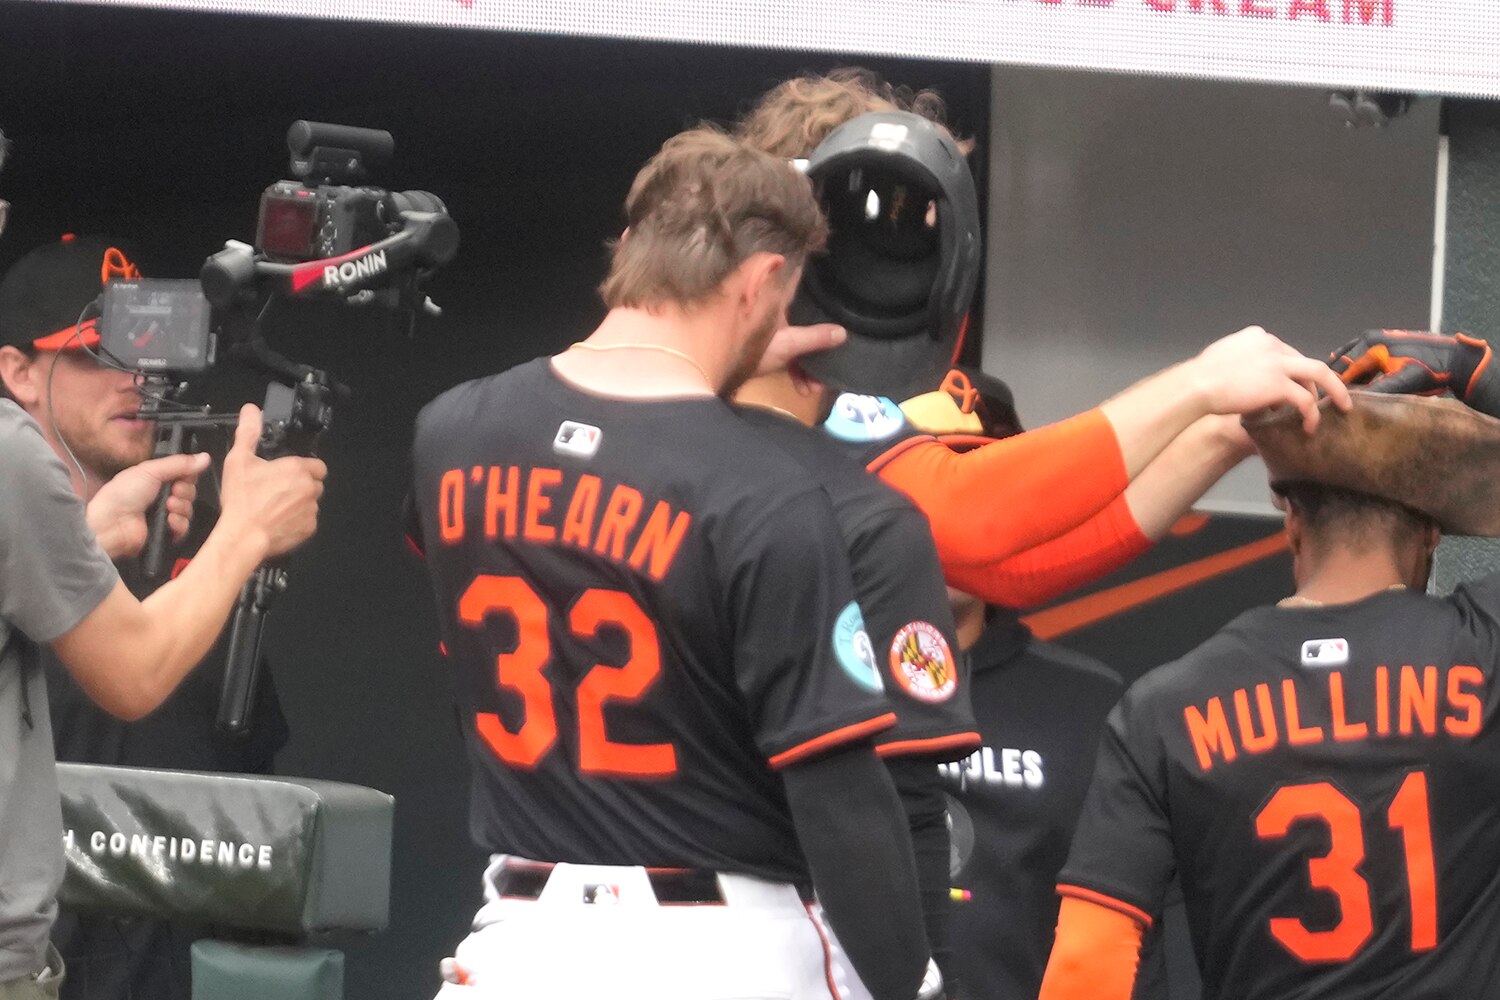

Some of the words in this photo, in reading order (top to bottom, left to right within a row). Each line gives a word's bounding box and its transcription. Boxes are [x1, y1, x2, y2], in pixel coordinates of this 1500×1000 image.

[323, 249, 387, 286] RONIN
[440, 466, 691, 580] O'HEARN
[459, 574, 677, 774] 32
[1184, 665, 1484, 769] MULLINS
[91, 831, 273, 870] CONFIDENCE
[1256, 771, 1437, 964] 31
